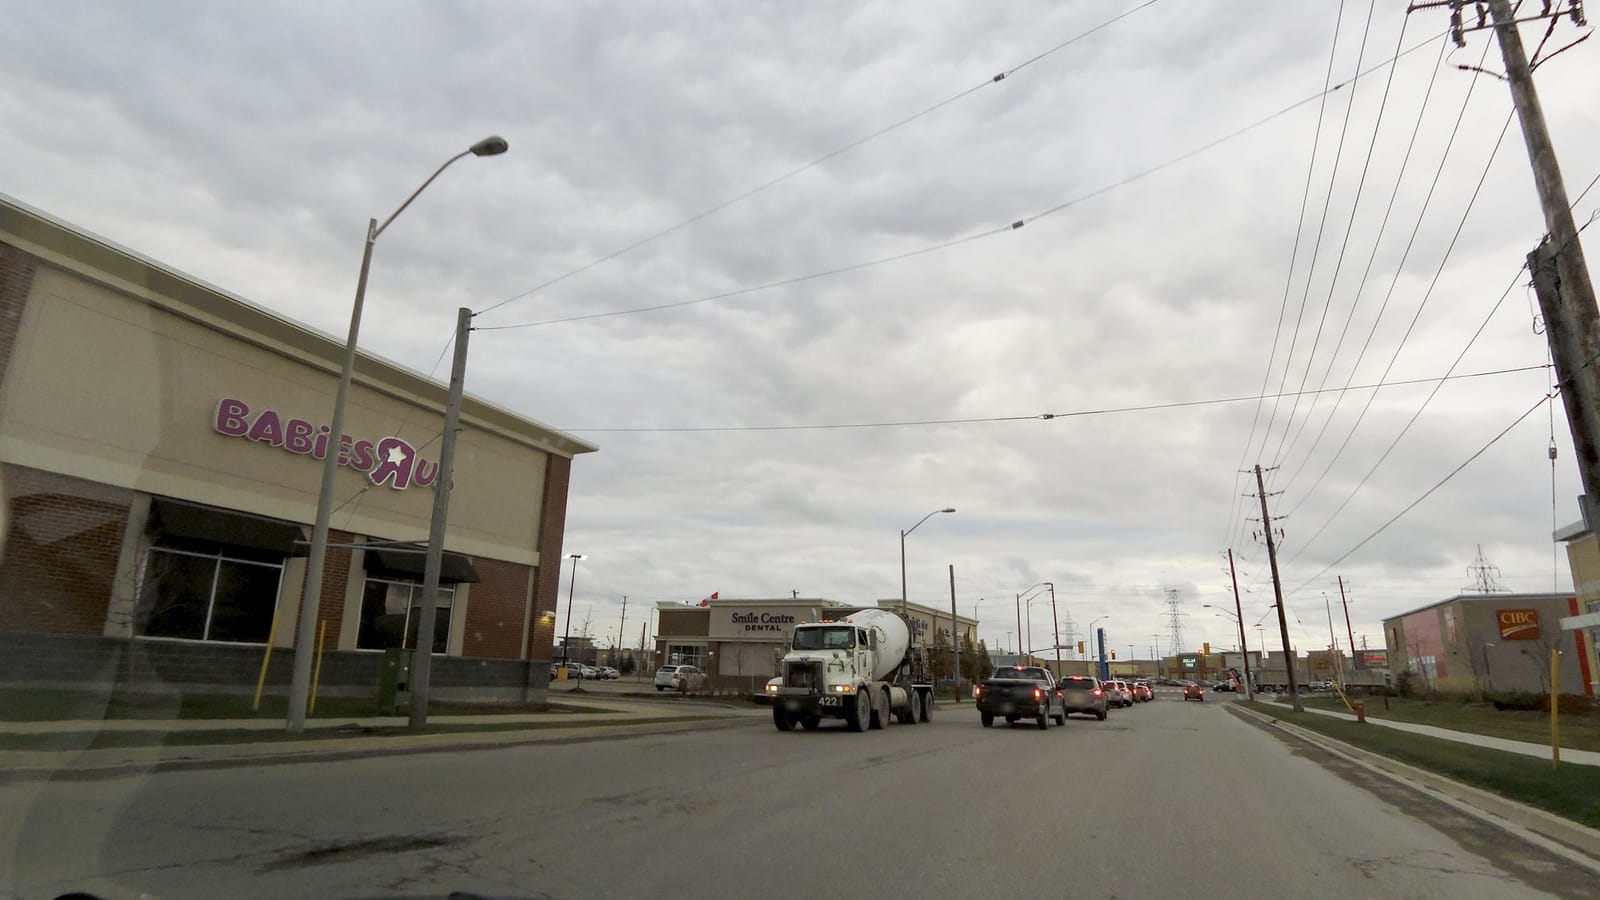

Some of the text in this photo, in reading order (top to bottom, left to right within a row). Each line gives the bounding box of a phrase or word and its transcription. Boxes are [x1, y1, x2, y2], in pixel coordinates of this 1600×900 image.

[414, 458, 455, 493] U
[731, 612, 795, 624] Smile Centre
[1500, 611, 1536, 624] CIBC
[818, 696, 837, 706] 422
